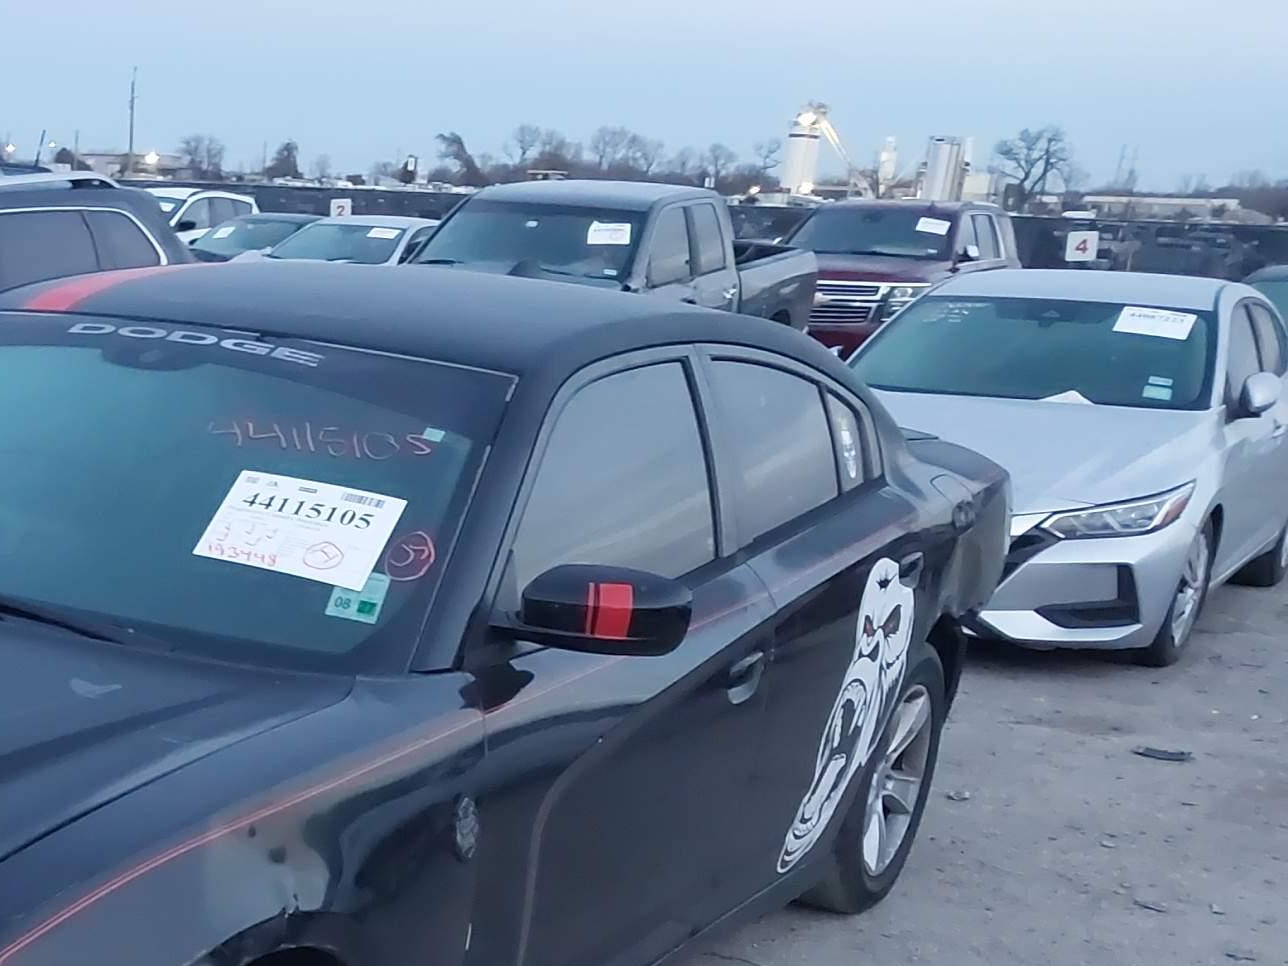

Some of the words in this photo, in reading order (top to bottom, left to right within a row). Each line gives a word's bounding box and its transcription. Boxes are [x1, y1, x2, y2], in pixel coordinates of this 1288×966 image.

[336, 205, 345, 217] 2
[1075, 239, 1089, 255] 4
[67, 323, 326, 368] DODGE
[208, 421, 432, 460] 44115105
[243, 492, 376, 530] 44115105
[334, 595, 352, 610] 08
